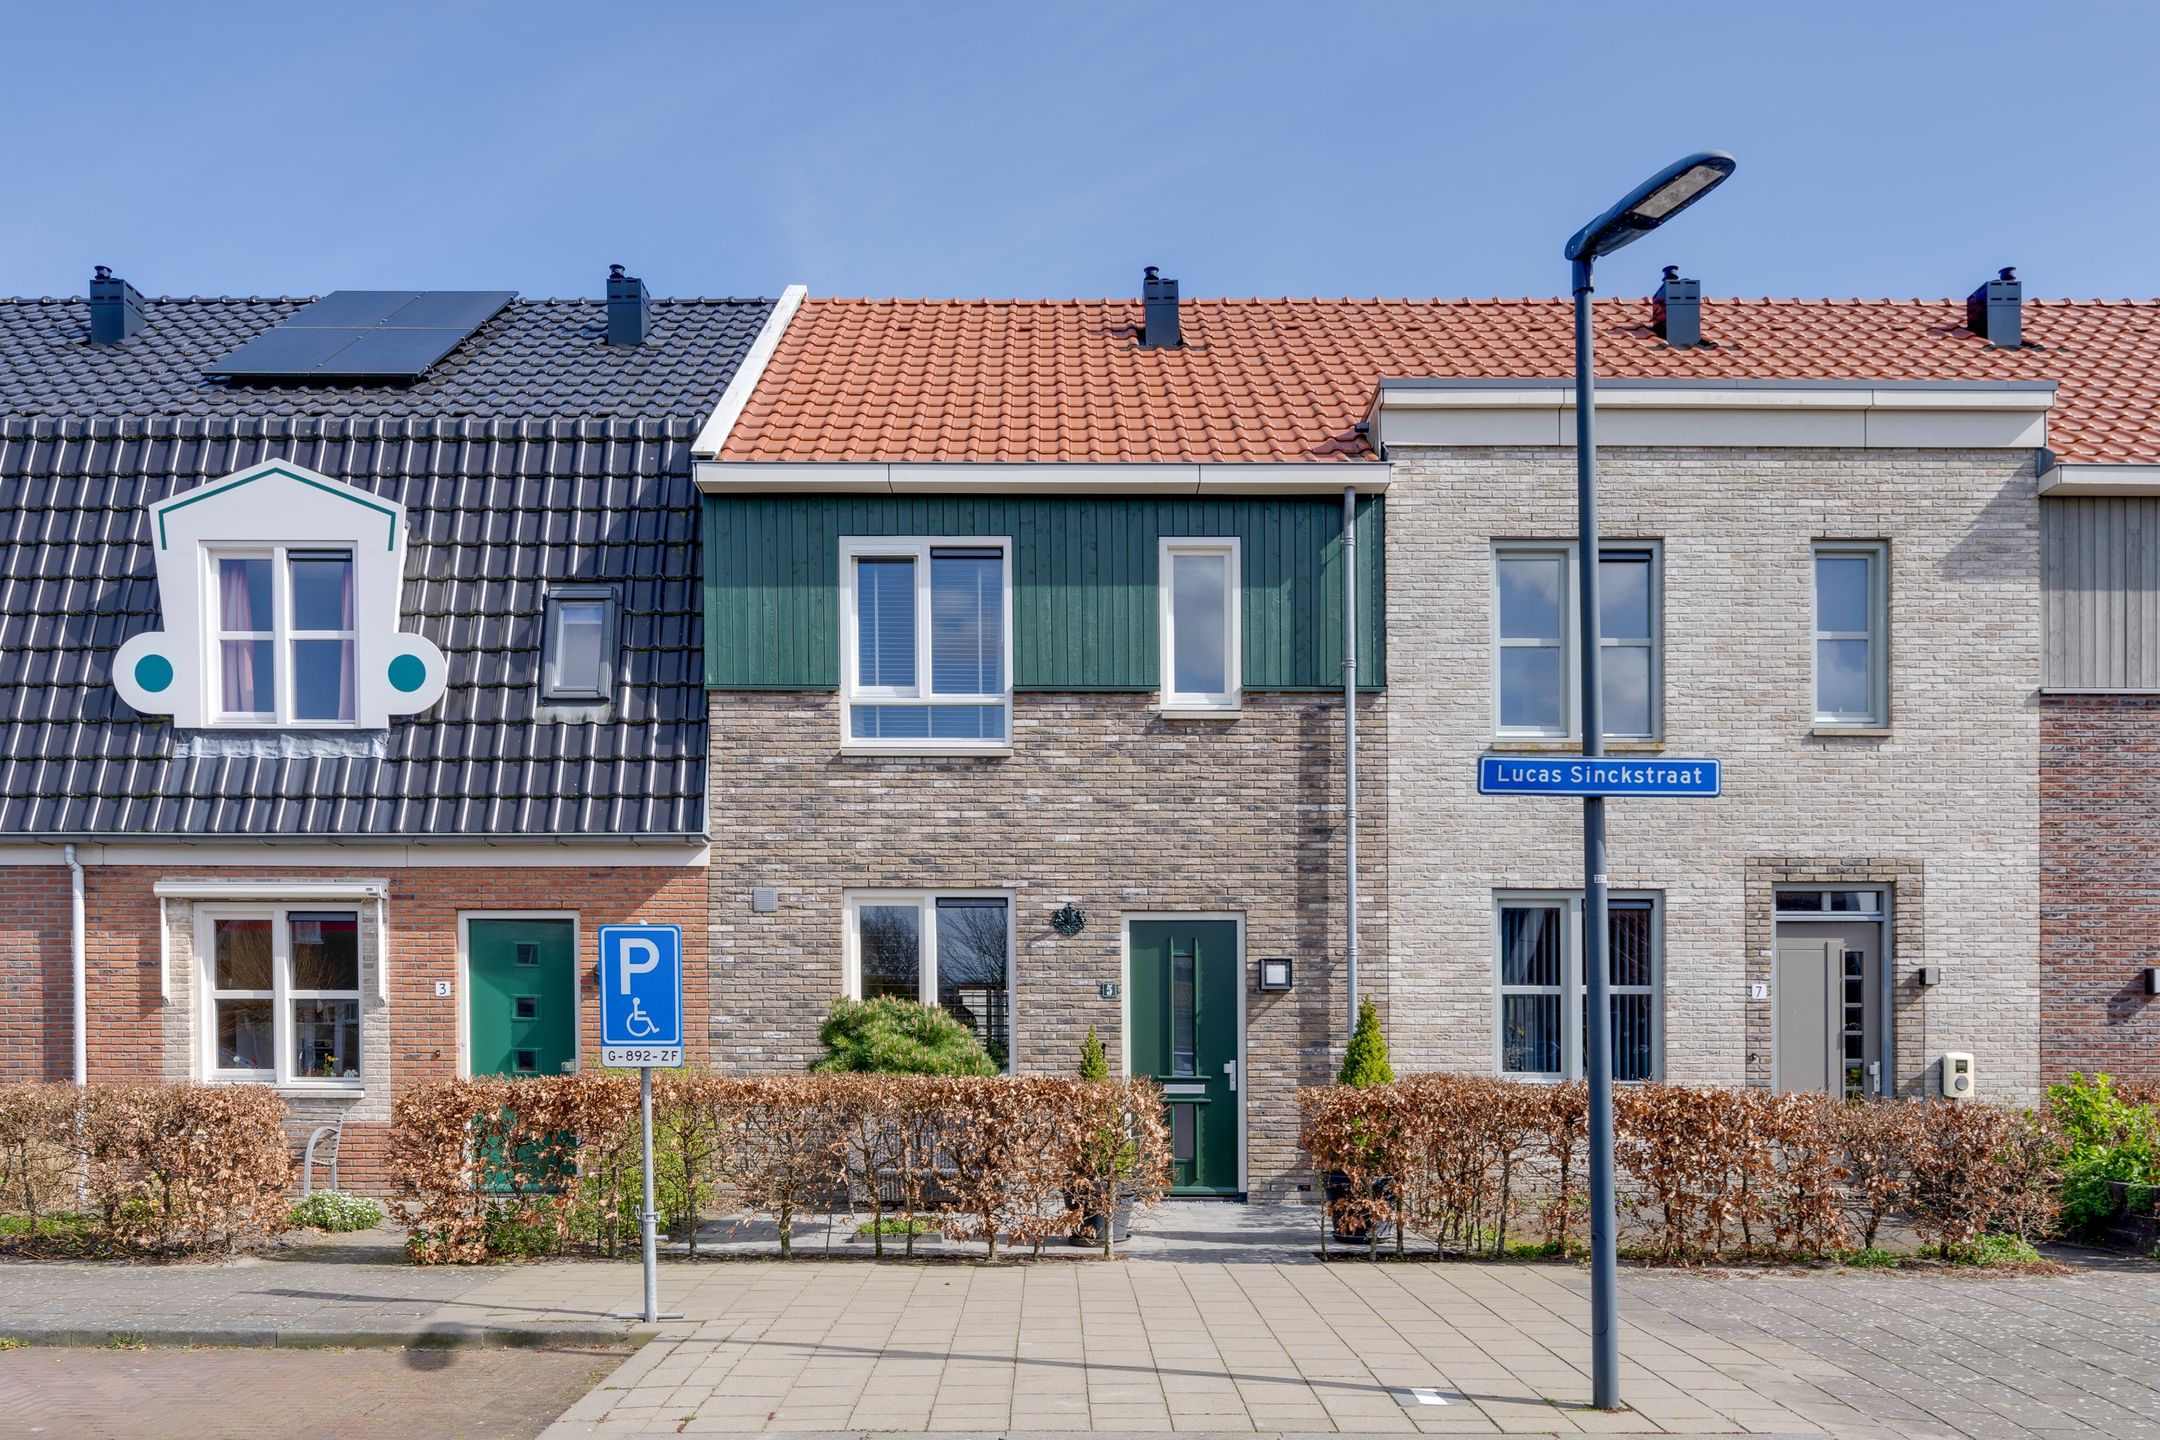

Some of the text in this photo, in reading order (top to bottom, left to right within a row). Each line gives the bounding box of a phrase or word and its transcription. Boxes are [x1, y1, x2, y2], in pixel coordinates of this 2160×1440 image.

[1498, 764, 1702, 784] Lucas Sinckstraat
[619, 937, 660, 995] P
[439, 983, 447, 995] 3
[1106, 984, 1113, 996] 5
[1755, 985, 1762, 997] 7
[608, 1050, 679, 1062] G-892-ZF
